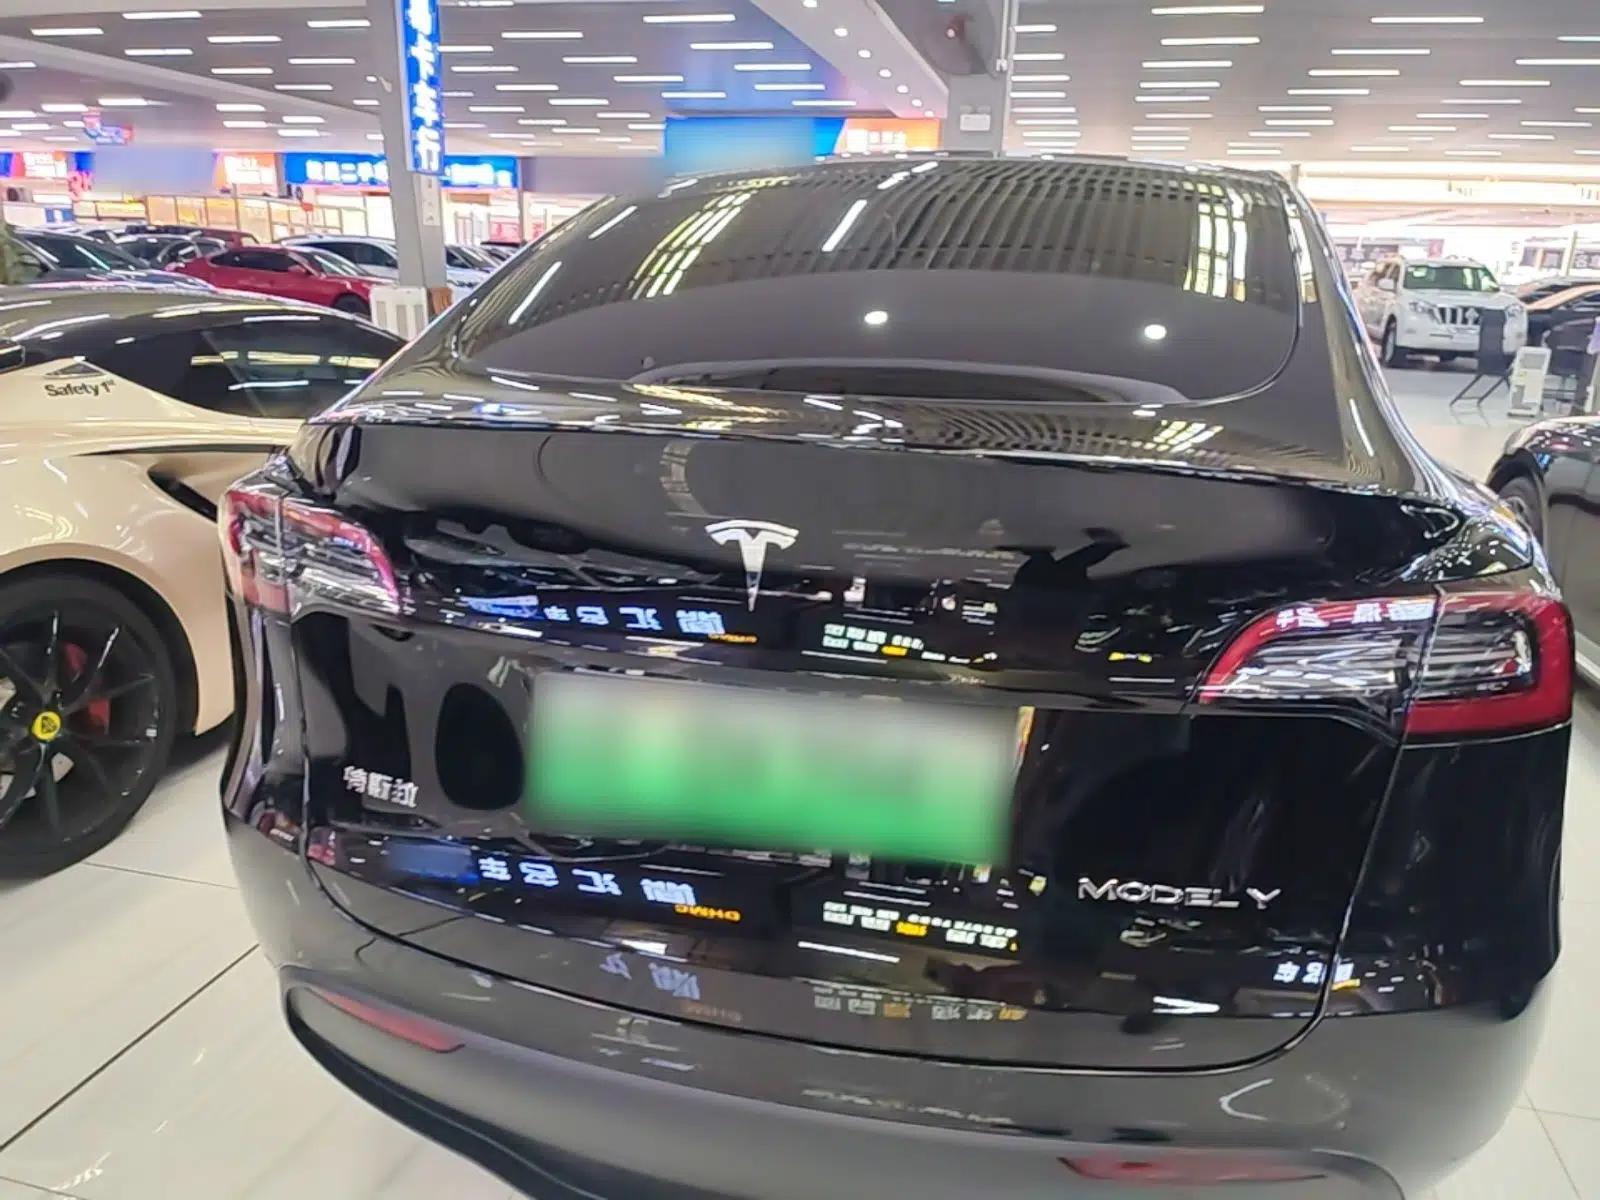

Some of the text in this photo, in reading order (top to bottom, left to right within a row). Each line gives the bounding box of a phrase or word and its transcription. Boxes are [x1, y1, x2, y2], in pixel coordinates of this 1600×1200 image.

[44, 383, 99, 397] Safety
[1078, 877, 1281, 909] MODEL Y
